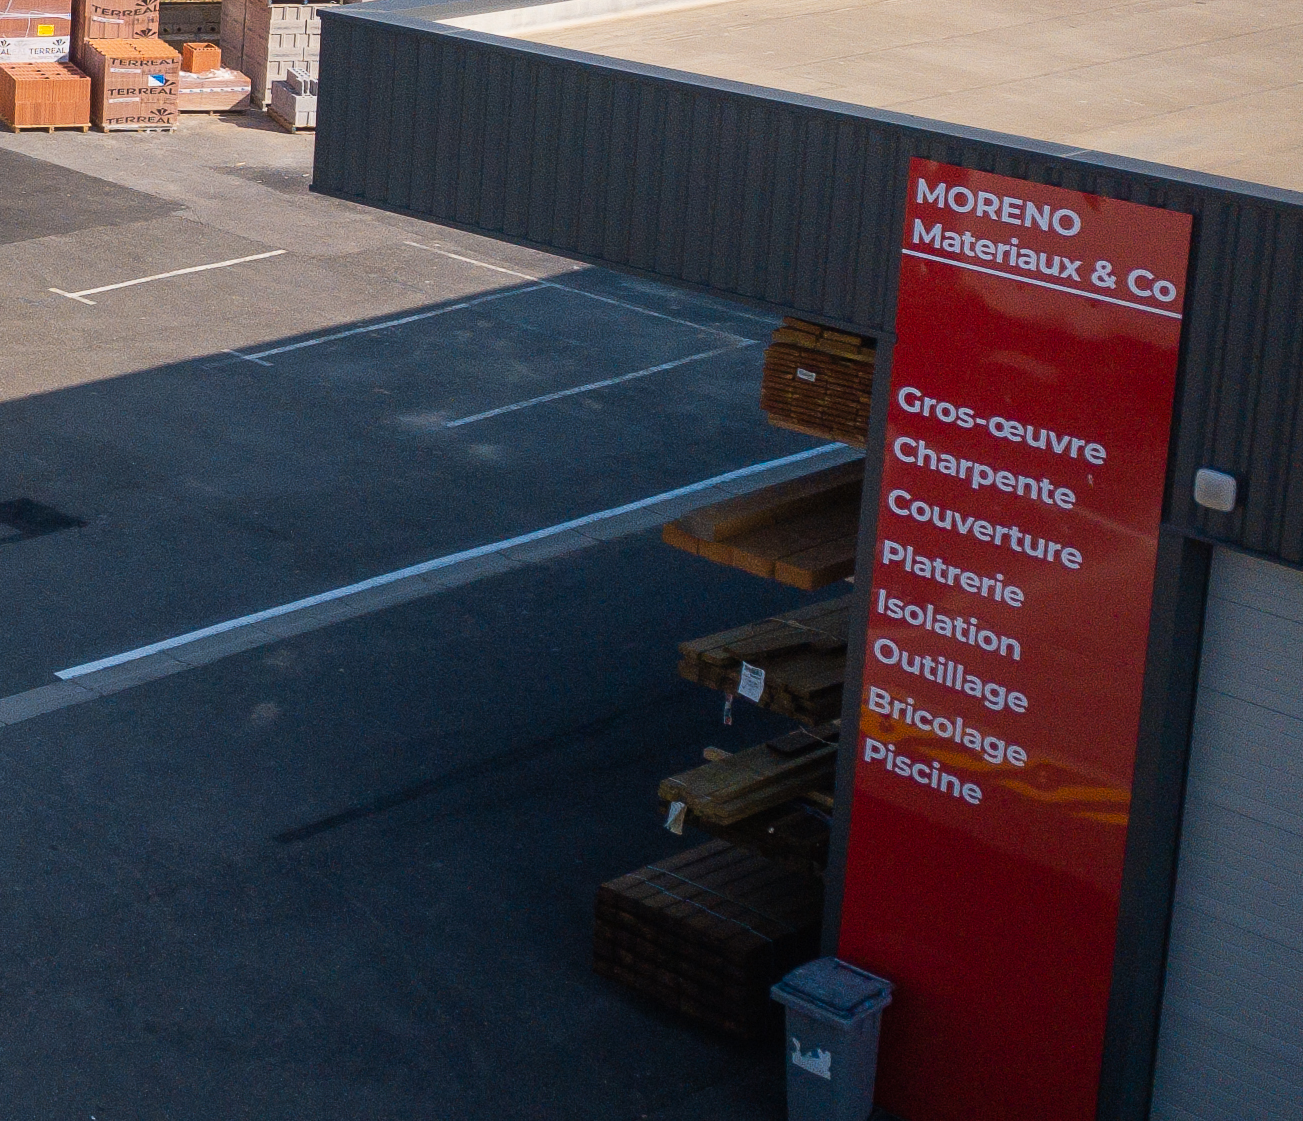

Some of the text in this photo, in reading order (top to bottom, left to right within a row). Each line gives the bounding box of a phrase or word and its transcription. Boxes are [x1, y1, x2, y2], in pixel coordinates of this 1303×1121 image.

[92, 4, 160, 17] TERREAL
[107, 87, 177, 96] TERREAL
[110, 57, 180, 67] TERREAL
[106, 116, 173, 125] TERREAL
[916, 177, 1082, 237] MORENO
[912, 218, 1177, 302] Materiaux & Co
[898, 386, 1107, 465] Gros-œuvre
[893, 437, 1076, 510] Charpente
[888, 489, 1083, 569] Couverture
[882, 539, 1025, 608] Platrerie
[876, 588, 1022, 661] Isolation
[873, 638, 1029, 713] Outillage
[868, 686, 1028, 768] Bricolage
[863, 737, 983, 805] Piscine
